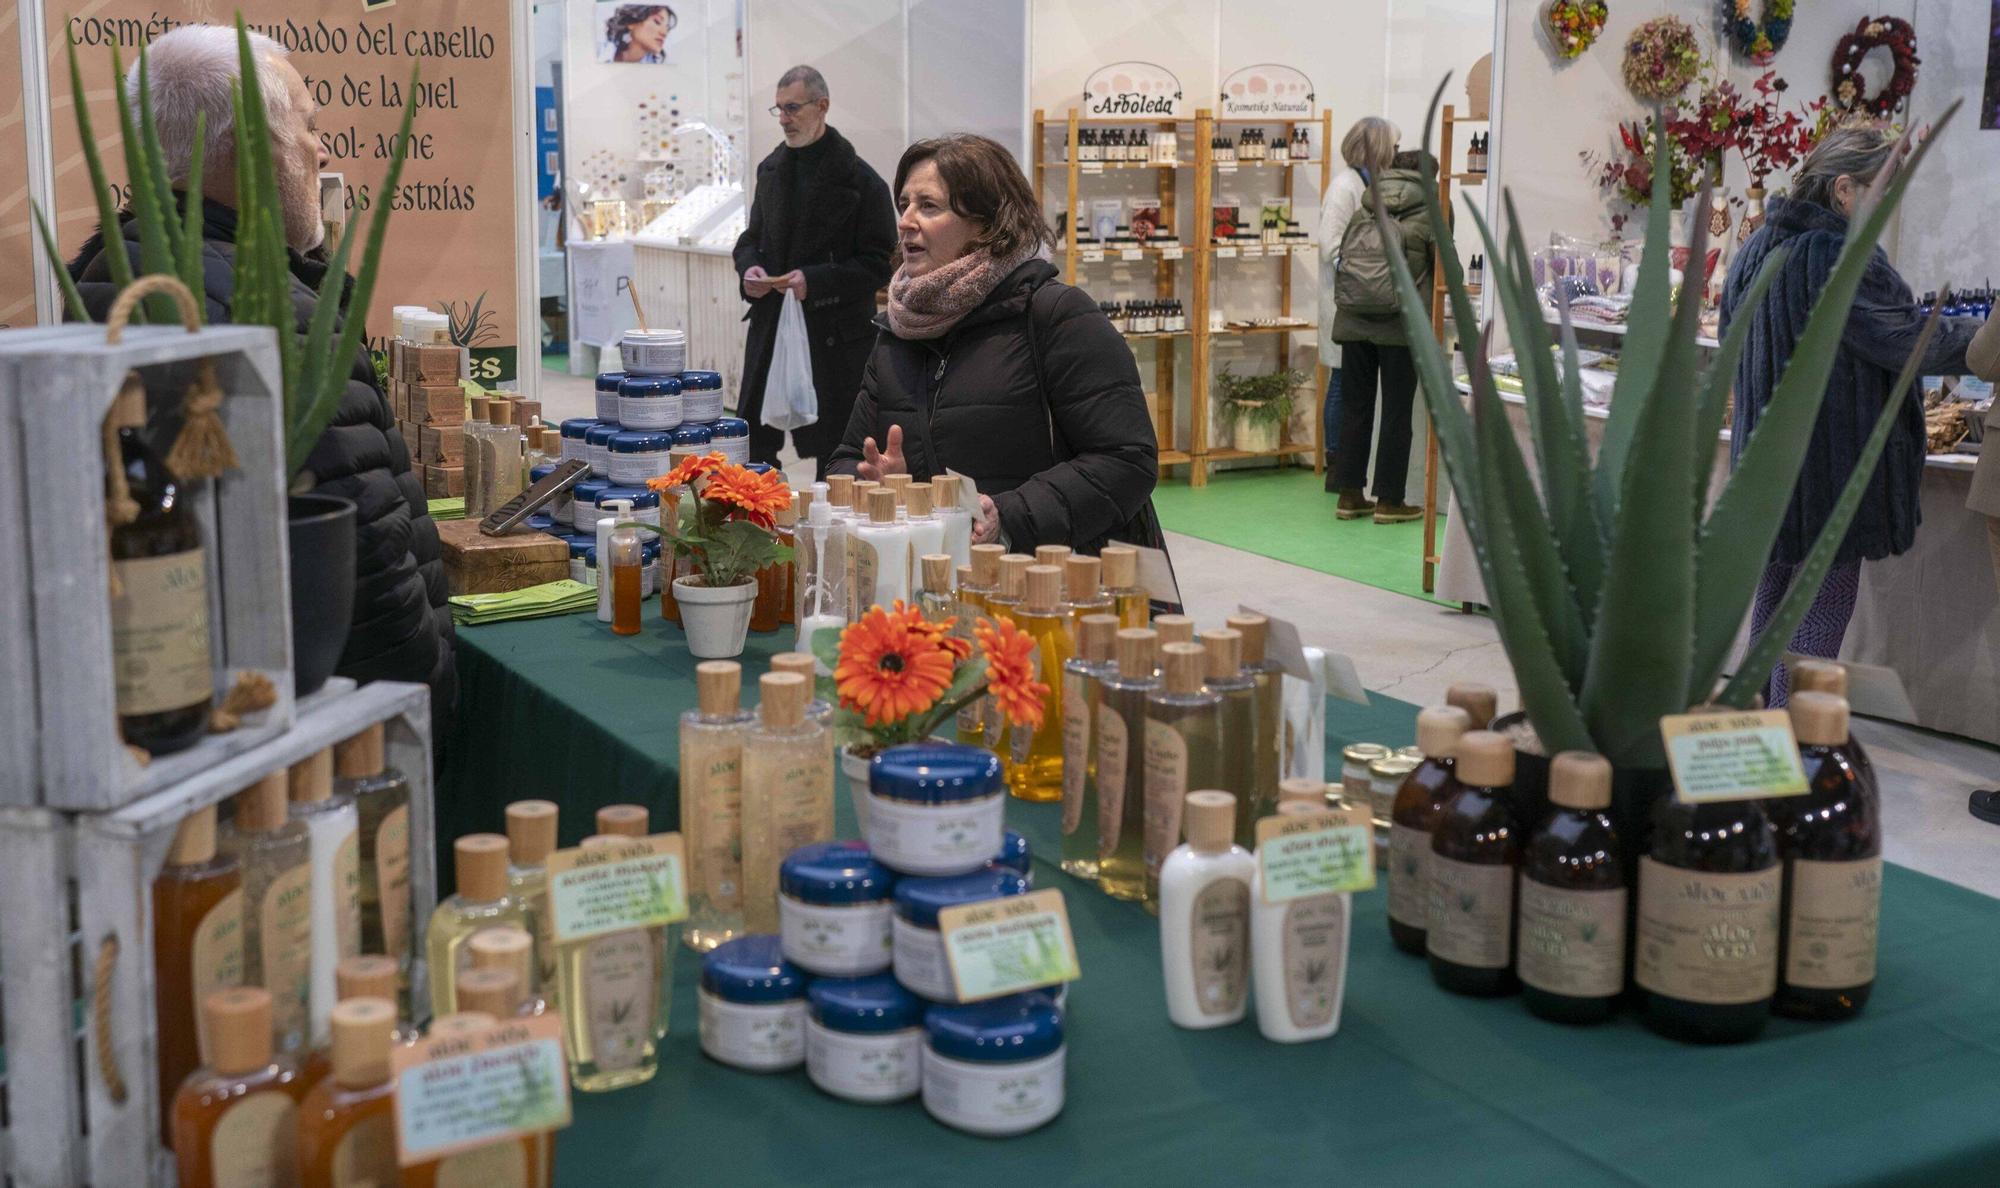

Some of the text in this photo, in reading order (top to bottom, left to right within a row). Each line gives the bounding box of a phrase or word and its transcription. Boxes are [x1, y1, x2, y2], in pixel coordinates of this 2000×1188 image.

[357, 21, 398, 56] del
[341, 73, 372, 107] de
[380, 74, 402, 107] la
[411, 77, 458, 117] piel
[1093, 92, 1174, 115] Arboleda
[1227, 102, 1308, 114] Kosmetika Naturala
[391, 177, 475, 211] estrías
